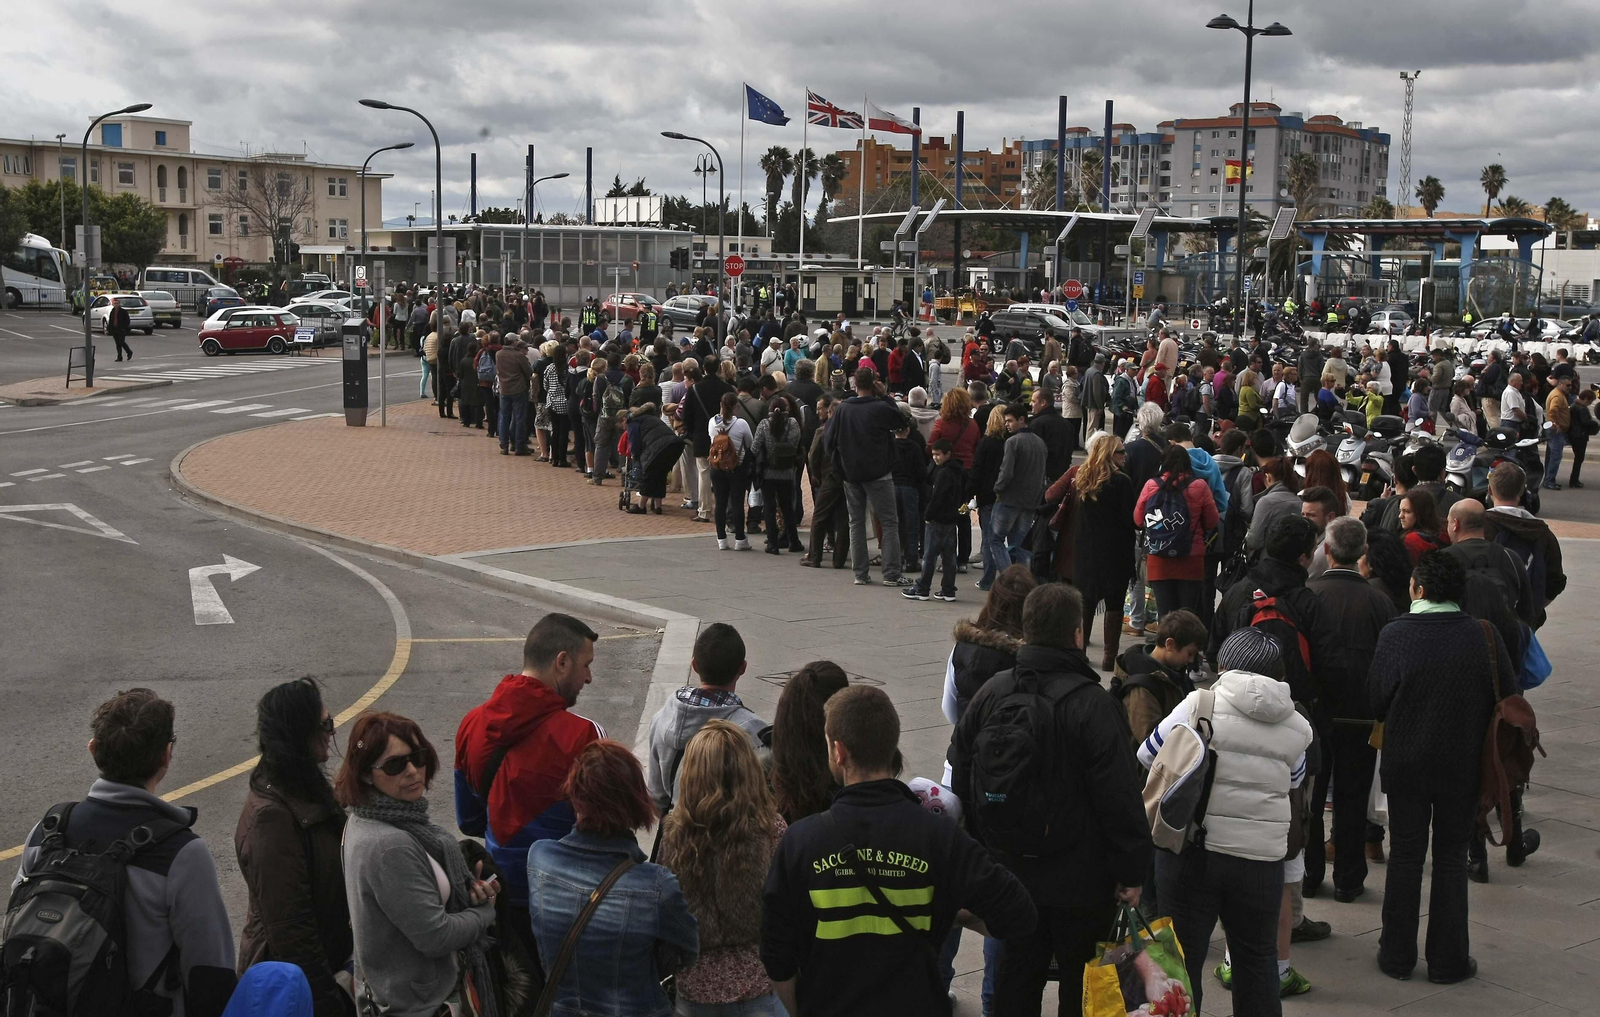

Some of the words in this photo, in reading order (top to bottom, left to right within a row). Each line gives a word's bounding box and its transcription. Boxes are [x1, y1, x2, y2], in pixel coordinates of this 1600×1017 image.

[725, 262, 744, 270] STOP
[361, 335, 366, 347] P
[812, 848, 873, 874] SACCNE
[875, 850, 884, 863] &
[886, 850, 929, 874] SPEED
[878, 869, 906, 877] LIMITED
